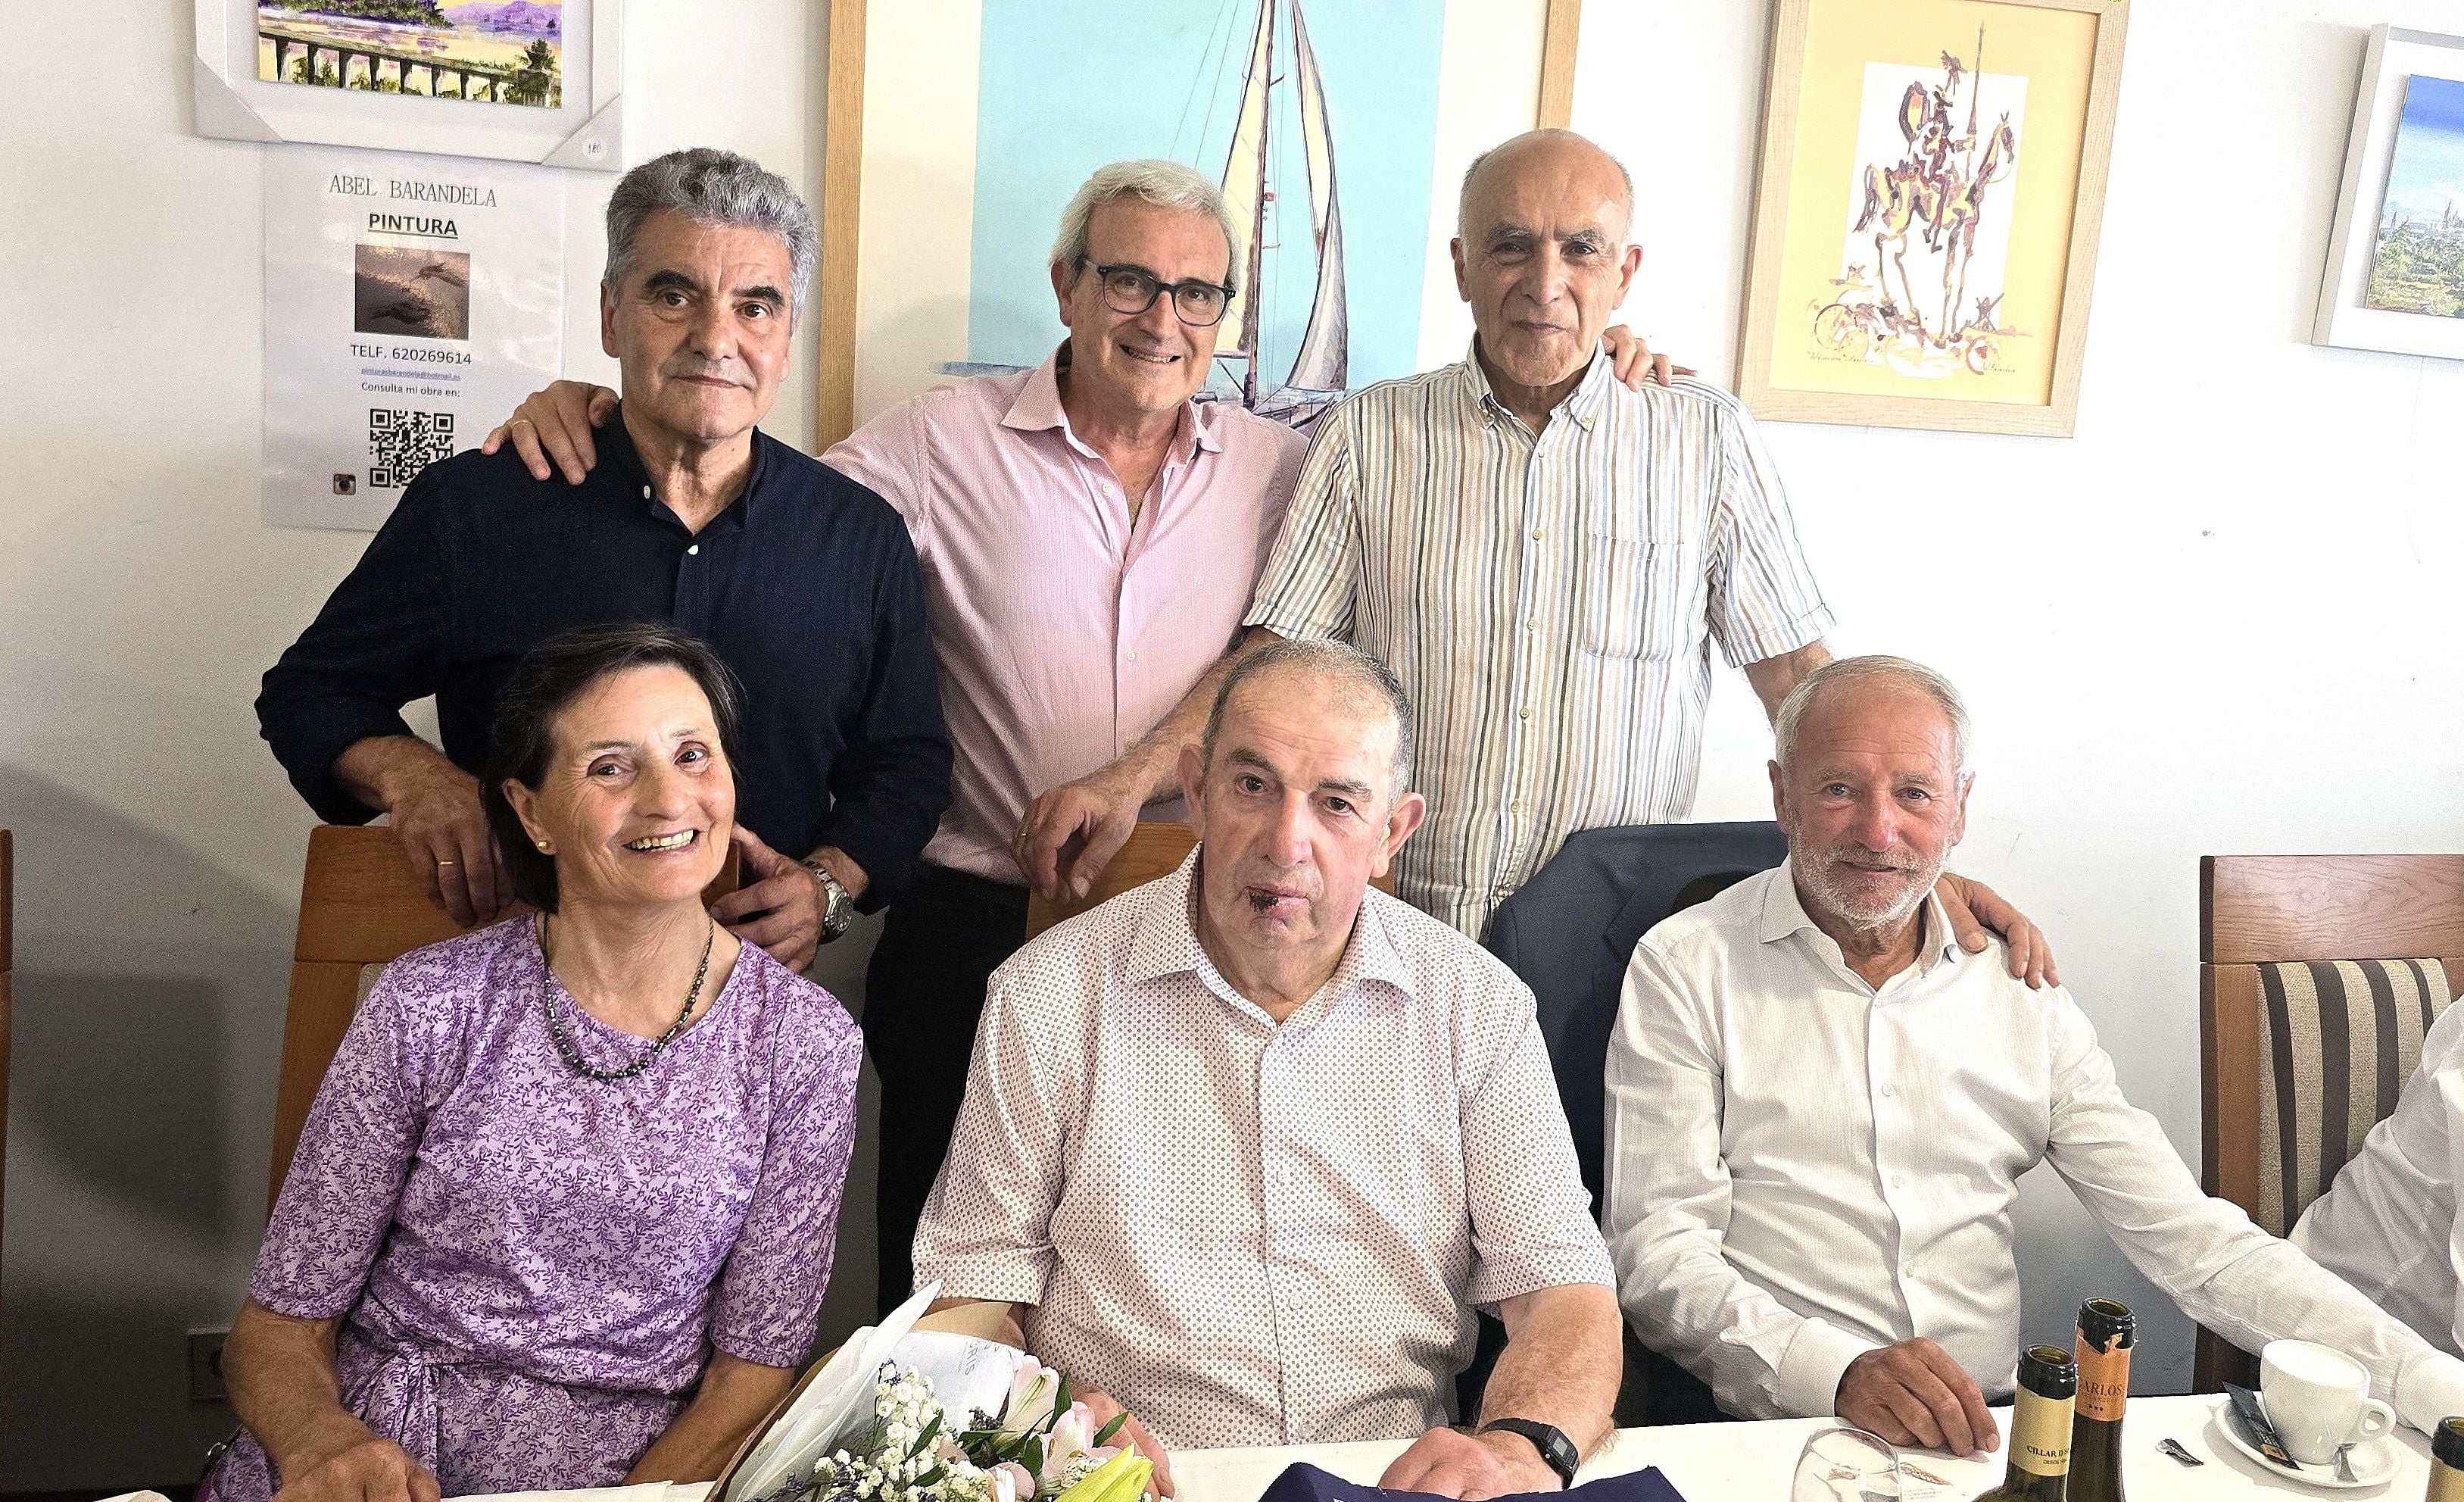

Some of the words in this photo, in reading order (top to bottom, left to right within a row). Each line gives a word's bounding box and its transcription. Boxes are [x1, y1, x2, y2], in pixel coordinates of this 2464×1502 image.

[329, 174, 378, 197] ABEL
[389, 180, 497, 208] BARANDELA
[368, 212, 459, 238] PINTURA
[351, 344, 387, 359] TELF.
[392, 348, 472, 365] 620269614
[361, 382, 403, 394] Consulta
[406, 386, 417, 395] mi
[420, 384, 442, 397] obra
[445, 389, 460, 398] en:
[2080, 1379, 2124, 1397] ARLOS
[2026, 1444, 2057, 1457] CILLAR
